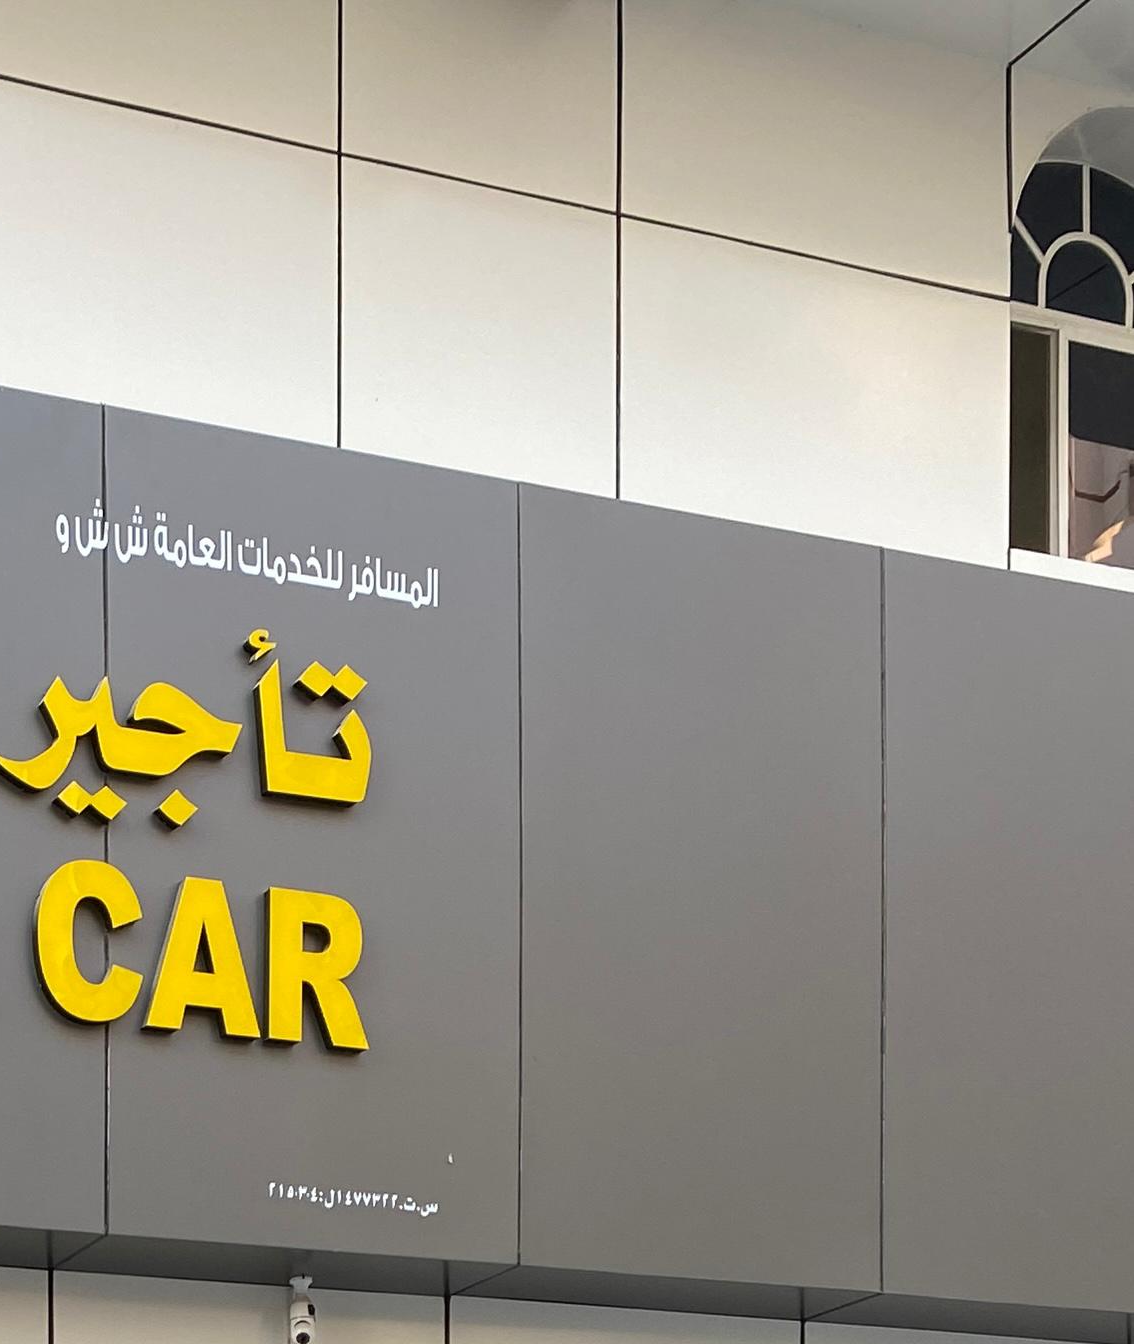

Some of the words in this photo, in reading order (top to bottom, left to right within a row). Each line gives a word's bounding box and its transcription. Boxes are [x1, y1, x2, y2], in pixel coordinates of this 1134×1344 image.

[55, 513, 70, 553] و
[74, 498, 109, 557] ش
[114, 505, 149, 563] ش
[153, 511, 233, 572] العامة
[237, 536, 344, 590] للخدمات
[347, 555, 439, 609] المسافر
[34, 857, 371, 1054] CAR
